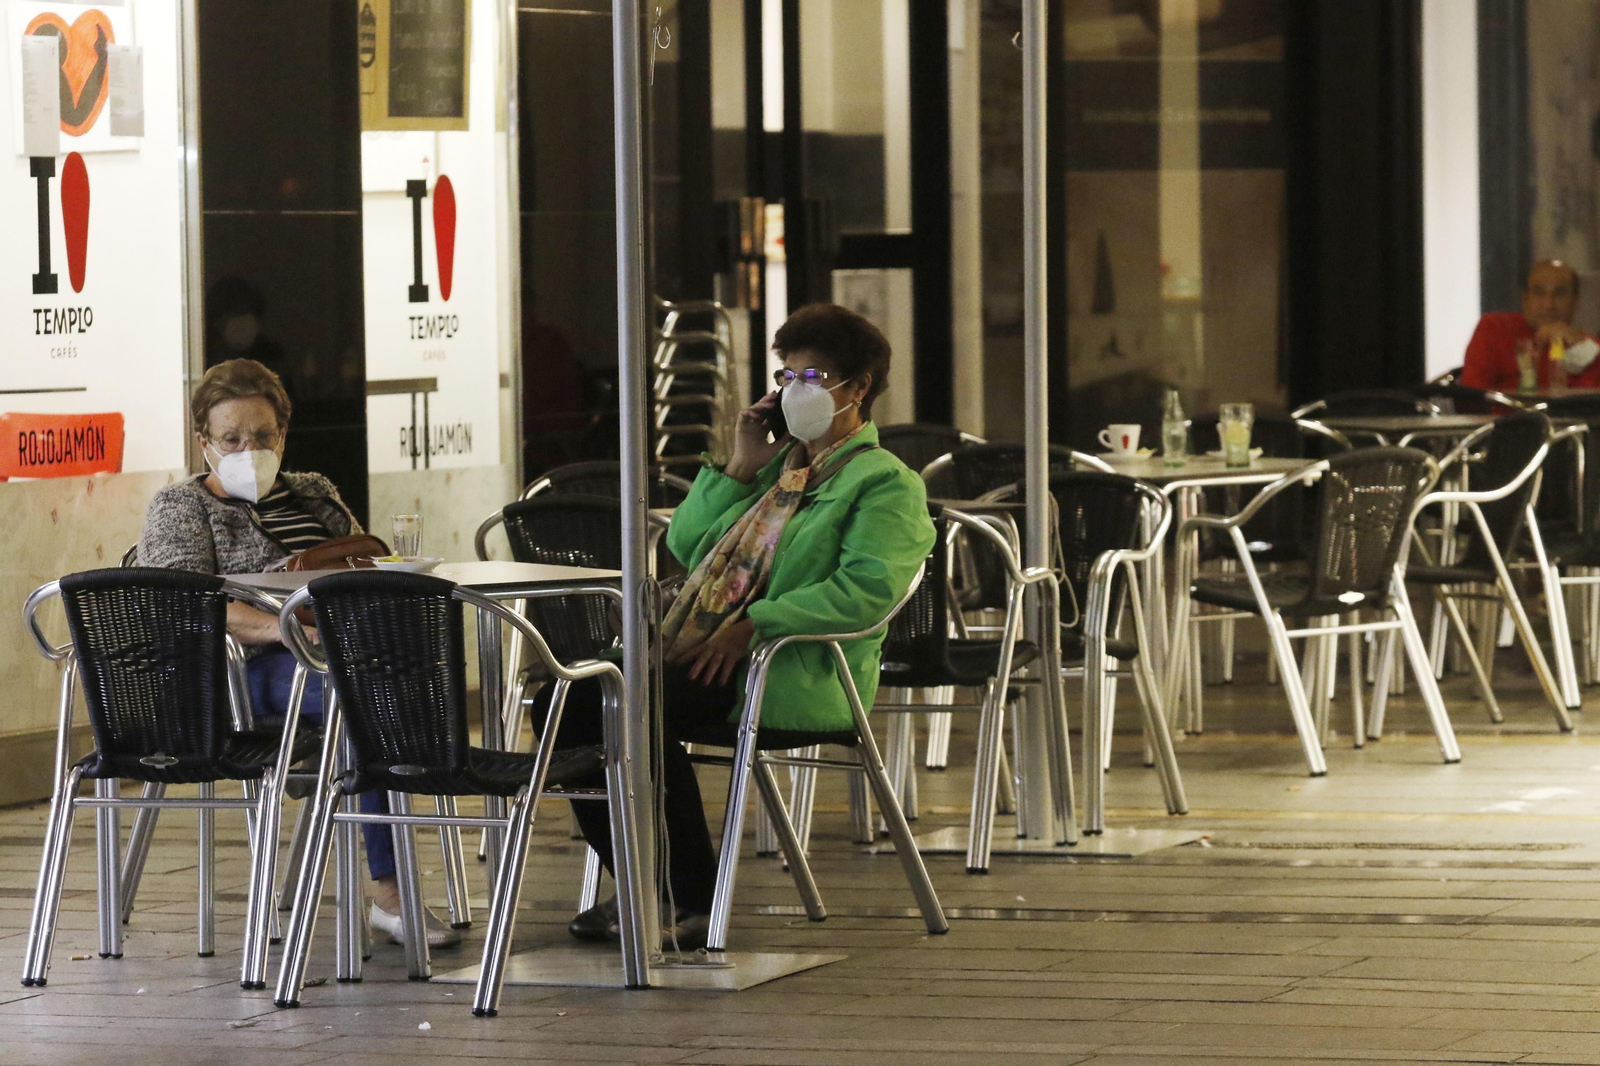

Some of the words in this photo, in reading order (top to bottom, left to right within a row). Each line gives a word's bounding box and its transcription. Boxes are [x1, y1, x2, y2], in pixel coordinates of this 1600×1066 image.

[33, 306, 94, 336] TEMPLO
[408, 314, 460, 340] TEMPLO
[50, 340, 78, 359] CAFÉS
[18, 420, 105, 467] ROJOJAMÓN
[400, 417, 472, 458] ROJJAMÓN
